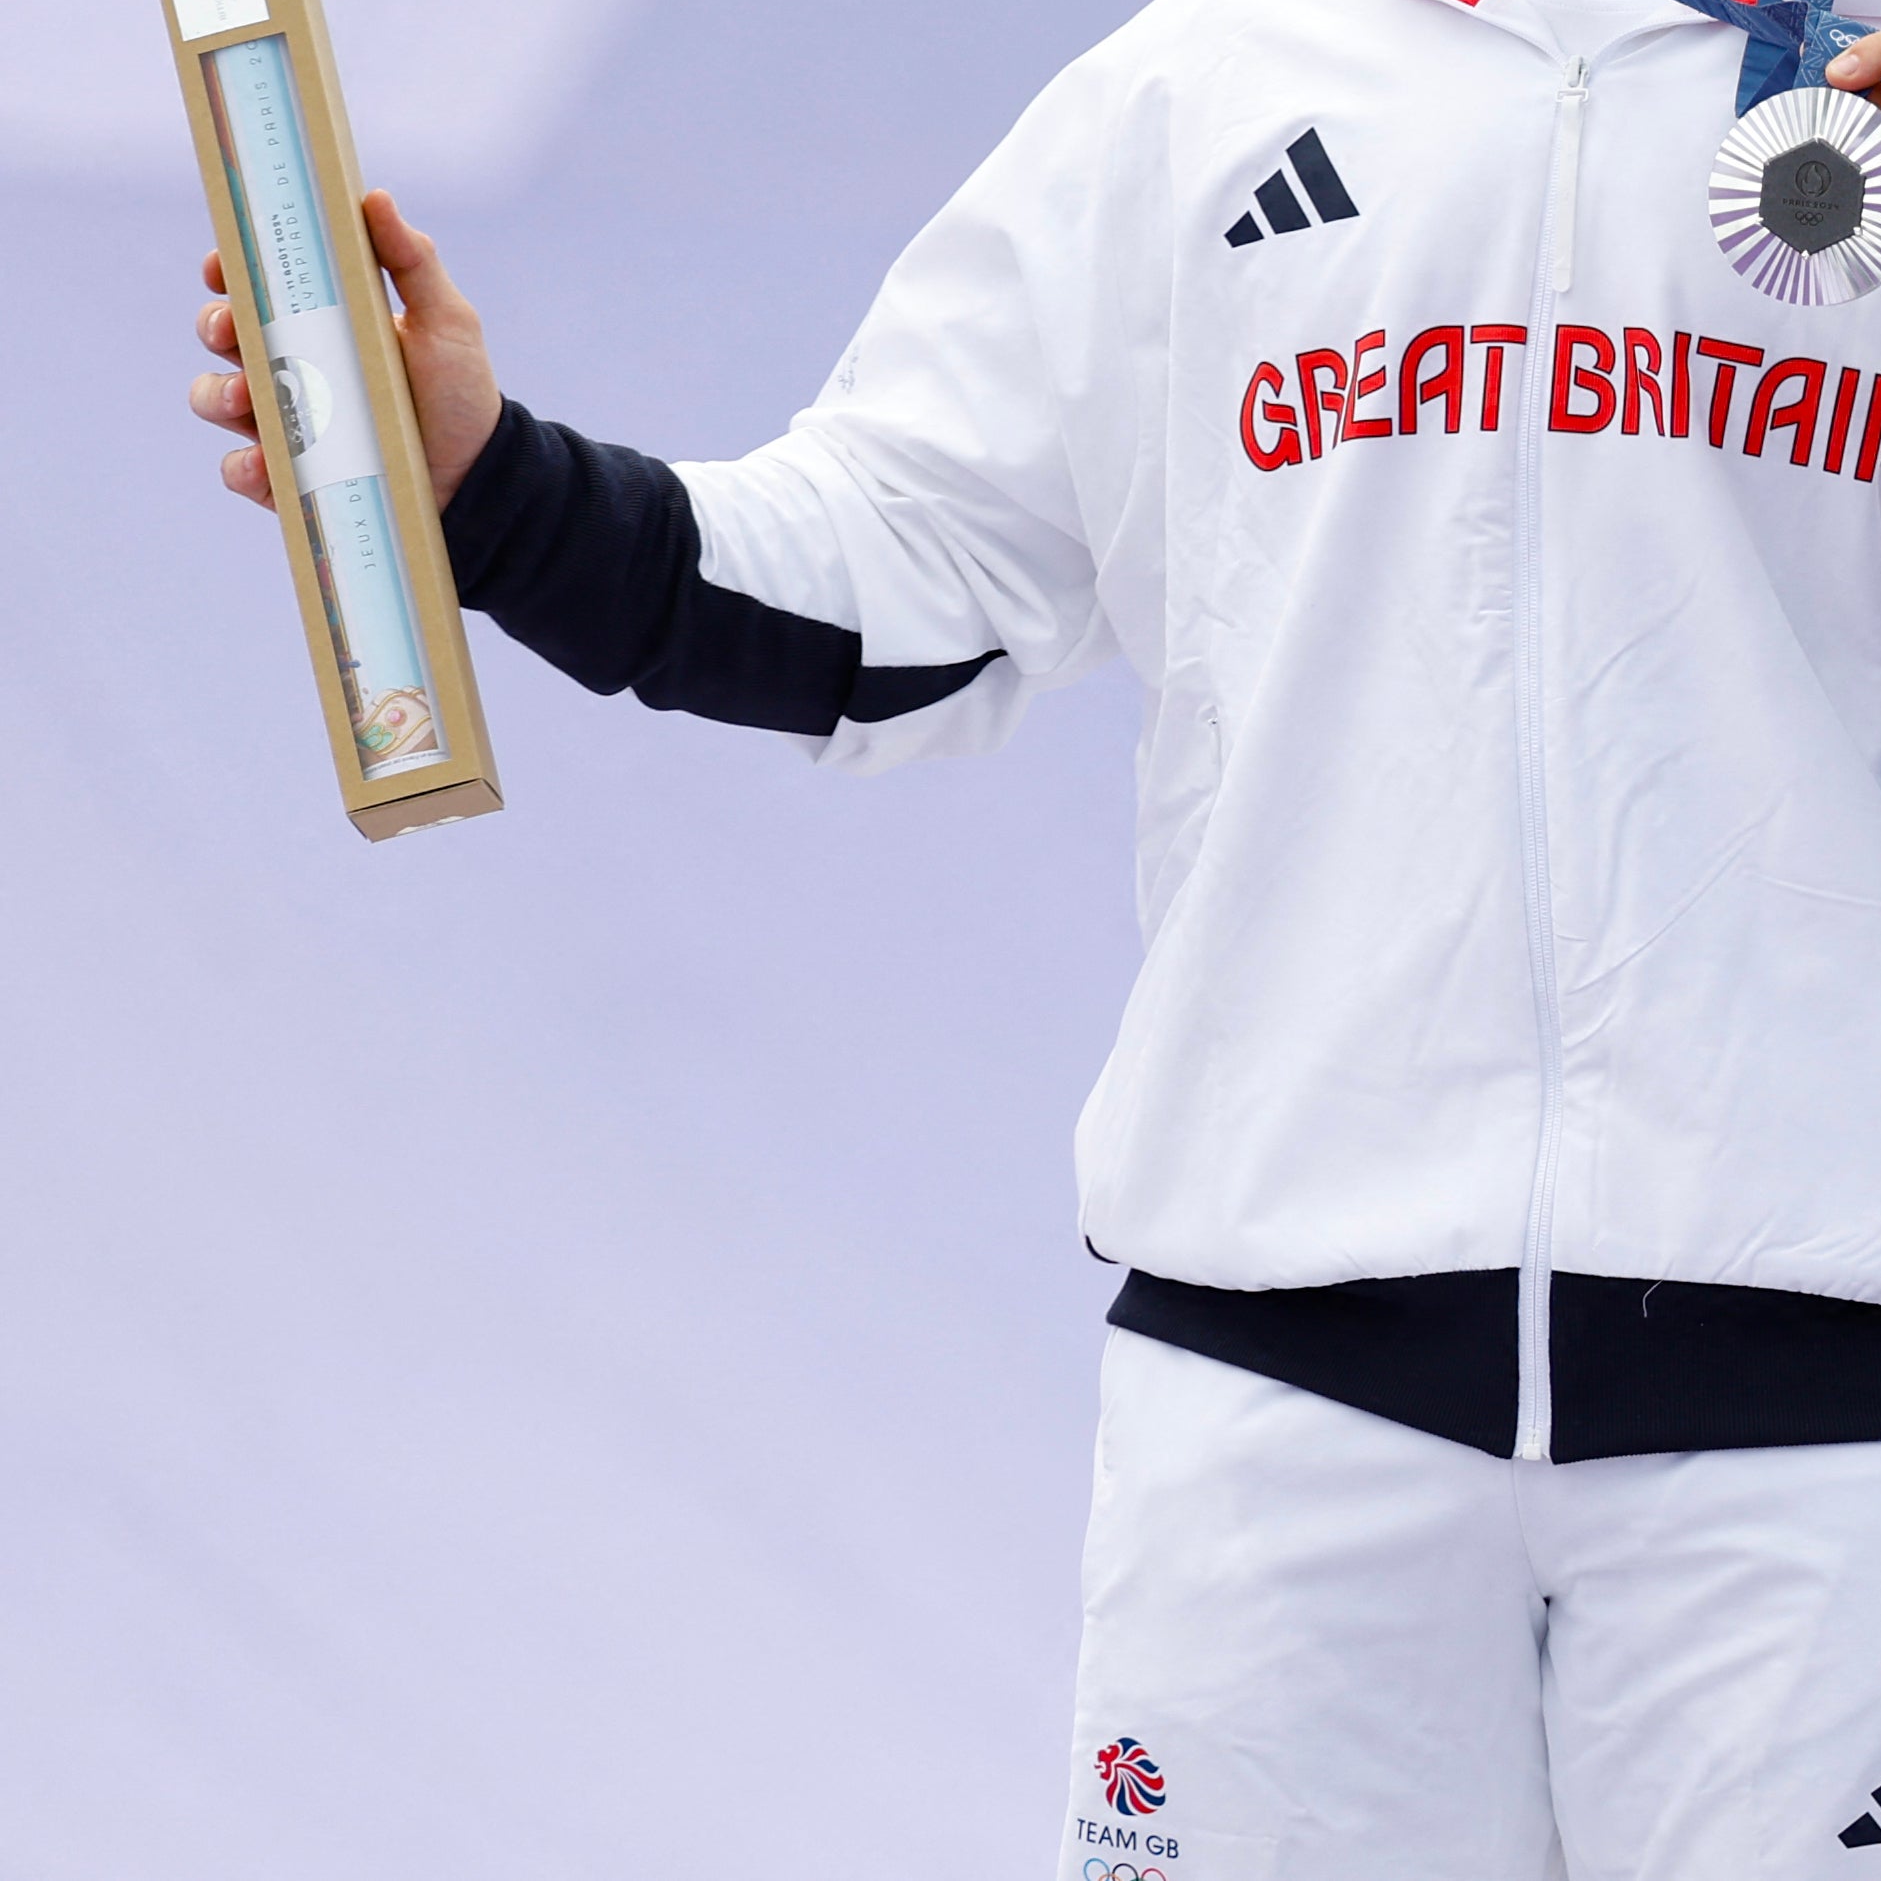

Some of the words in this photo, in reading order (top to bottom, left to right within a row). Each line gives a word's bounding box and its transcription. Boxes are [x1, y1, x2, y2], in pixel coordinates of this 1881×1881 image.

[245, 41, 261, 65] 20
[254, 80, 280, 146] PARIS
[272, 161, 289, 185] DE
[1782, 196, 1811, 209] PARIS
[1812, 199, 1839, 210] 2024
[270, 213, 284, 242] 2024
[275, 246, 292, 276] AOÛT
[281, 201, 317, 311] LYMPIADE
[285, 279, 295, 289] 11
[1239, 323, 1527, 472] GREAT
[344, 478, 361, 503] DE
[353, 517, 377, 569] JEUX
[1077, 1818, 1136, 1851] TEAM
[1146, 1835, 1179, 1859] GB
